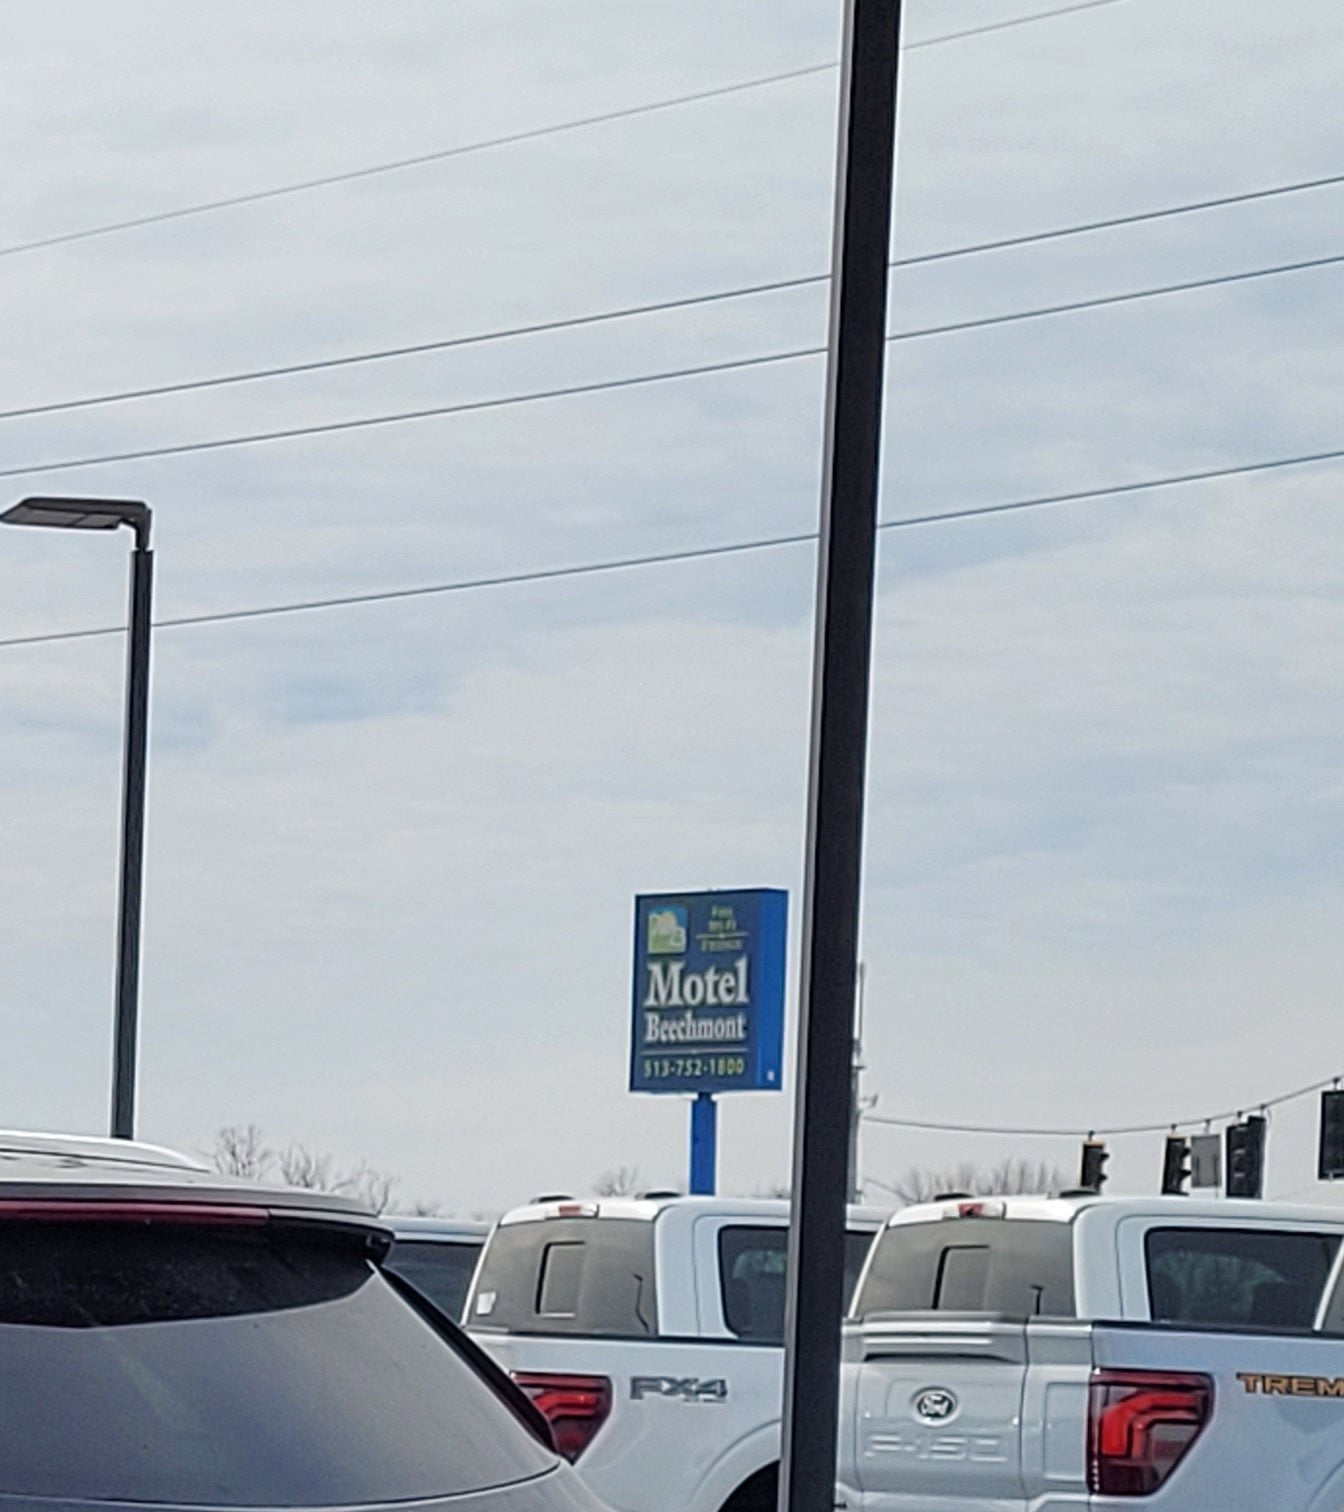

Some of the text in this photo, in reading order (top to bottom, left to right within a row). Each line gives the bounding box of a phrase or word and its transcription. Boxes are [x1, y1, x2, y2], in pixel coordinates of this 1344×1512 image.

[643, 955, 750, 1007] Motel
[643, 1010, 747, 1043] Beechmont
[629, 1376, 728, 1403] FX4
[864, 1432, 1009, 1463] F-150
